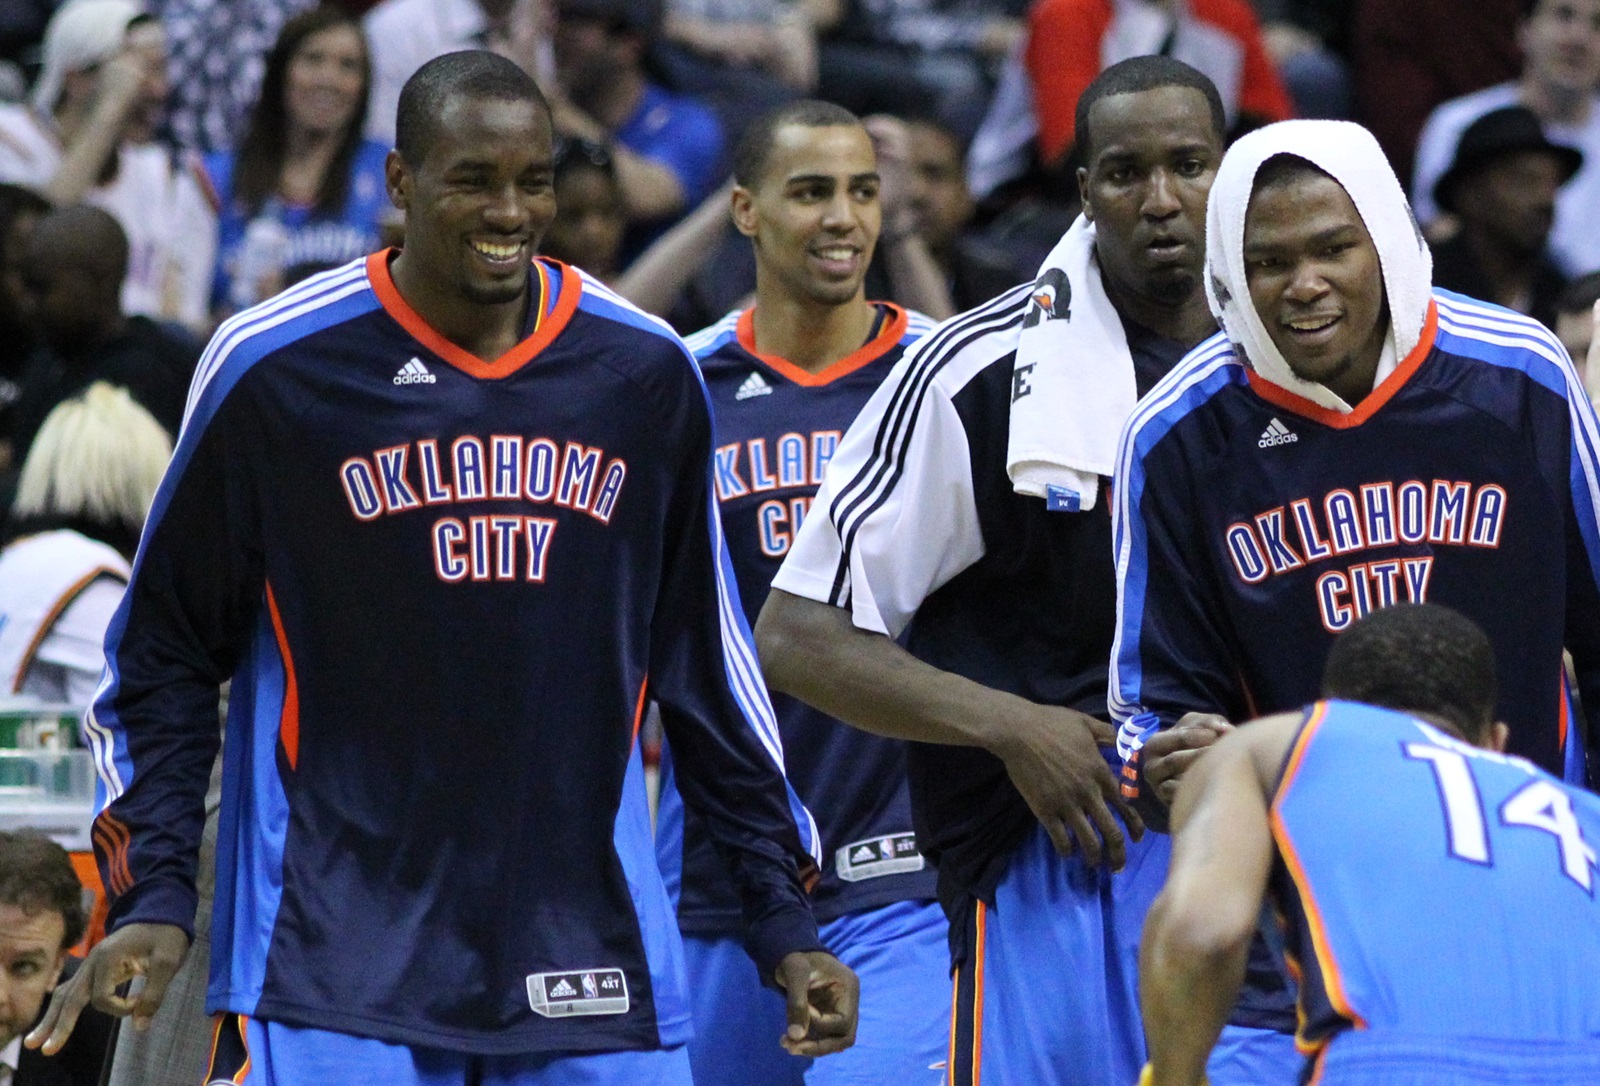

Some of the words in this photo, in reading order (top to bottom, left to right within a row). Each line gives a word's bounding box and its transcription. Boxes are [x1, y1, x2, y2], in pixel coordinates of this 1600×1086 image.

[392, 373, 437, 385] adidas
[1257, 432, 1299, 449] adidas
[339, 434, 627, 525] OKLAHOMA
[431, 514, 557, 583] CITY
[1226, 478, 1508, 585] OKLAHOMA
[1315, 556, 1434, 634] CITY
[1399, 740, 1600, 899] 14
[601, 979, 619, 989] 4XT
